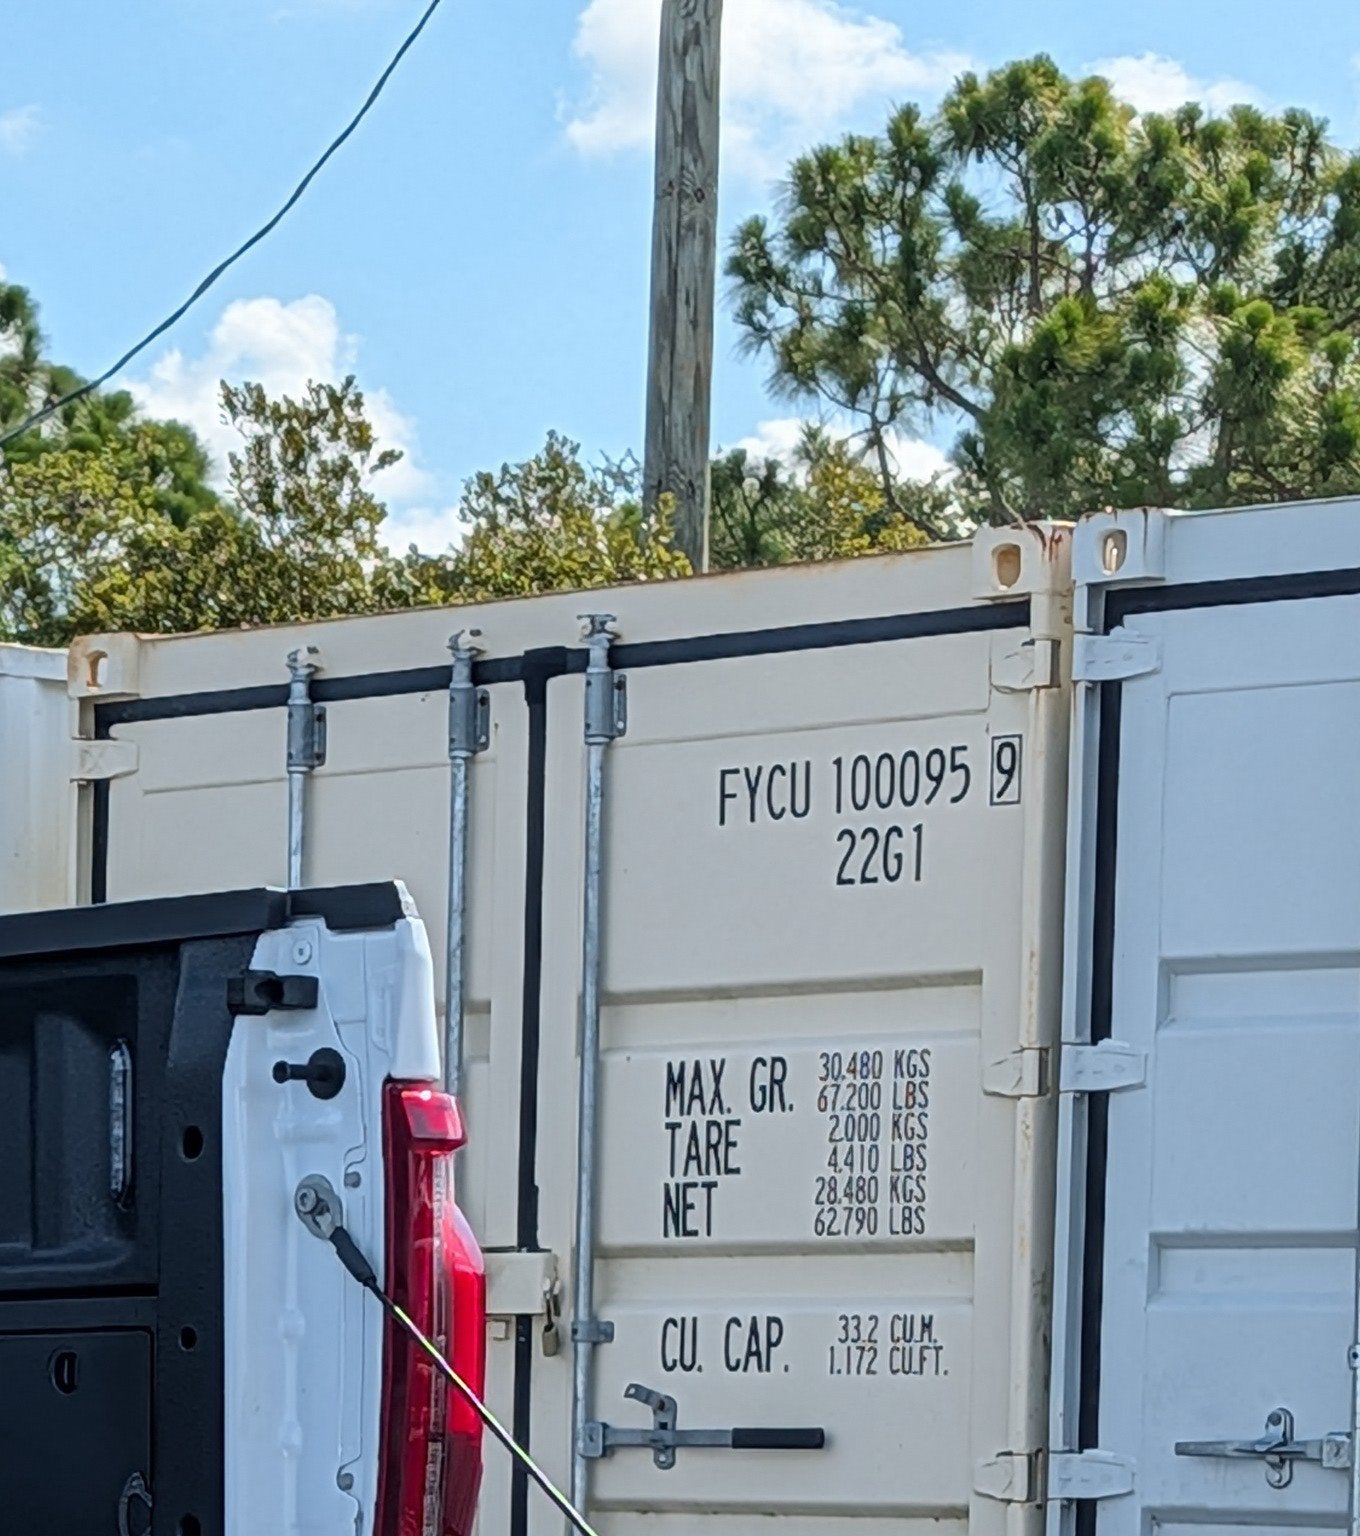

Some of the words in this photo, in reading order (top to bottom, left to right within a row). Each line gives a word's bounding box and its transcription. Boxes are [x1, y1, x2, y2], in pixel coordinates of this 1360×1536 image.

[718, 759, 811, 827] FYCU
[831, 745, 972, 815] 100095
[994, 739, 1019, 801] 9
[835, 823, 924, 886] 22G1
[817, 1050, 883, 1081] 30.480
[893, 1048, 931, 1079] KGS
[664, 1057, 732, 1118] MAX.
[749, 1055, 794, 1113] GR.
[817, 1081, 882, 1112] 67.200
[892, 1080, 930, 1111] LBS
[891, 1111, 929, 1142] KGS
[664, 1118, 741, 1178] TARE
[827, 1143, 880, 1174] 4.410
[890, 1142, 927, 1173] LBS
[814, 1175, 879, 1206] 28.480
[889, 1173, 927, 1204] KGS
[662, 1180, 719, 1238] NET
[889, 1205, 926, 1235] LBS
[660, 1315, 703, 1373] CU.
[723, 1315, 790, 1373] CAP.
[837, 1313, 879, 1344] 33.2
[829, 1345, 878, 1375] 1.172
